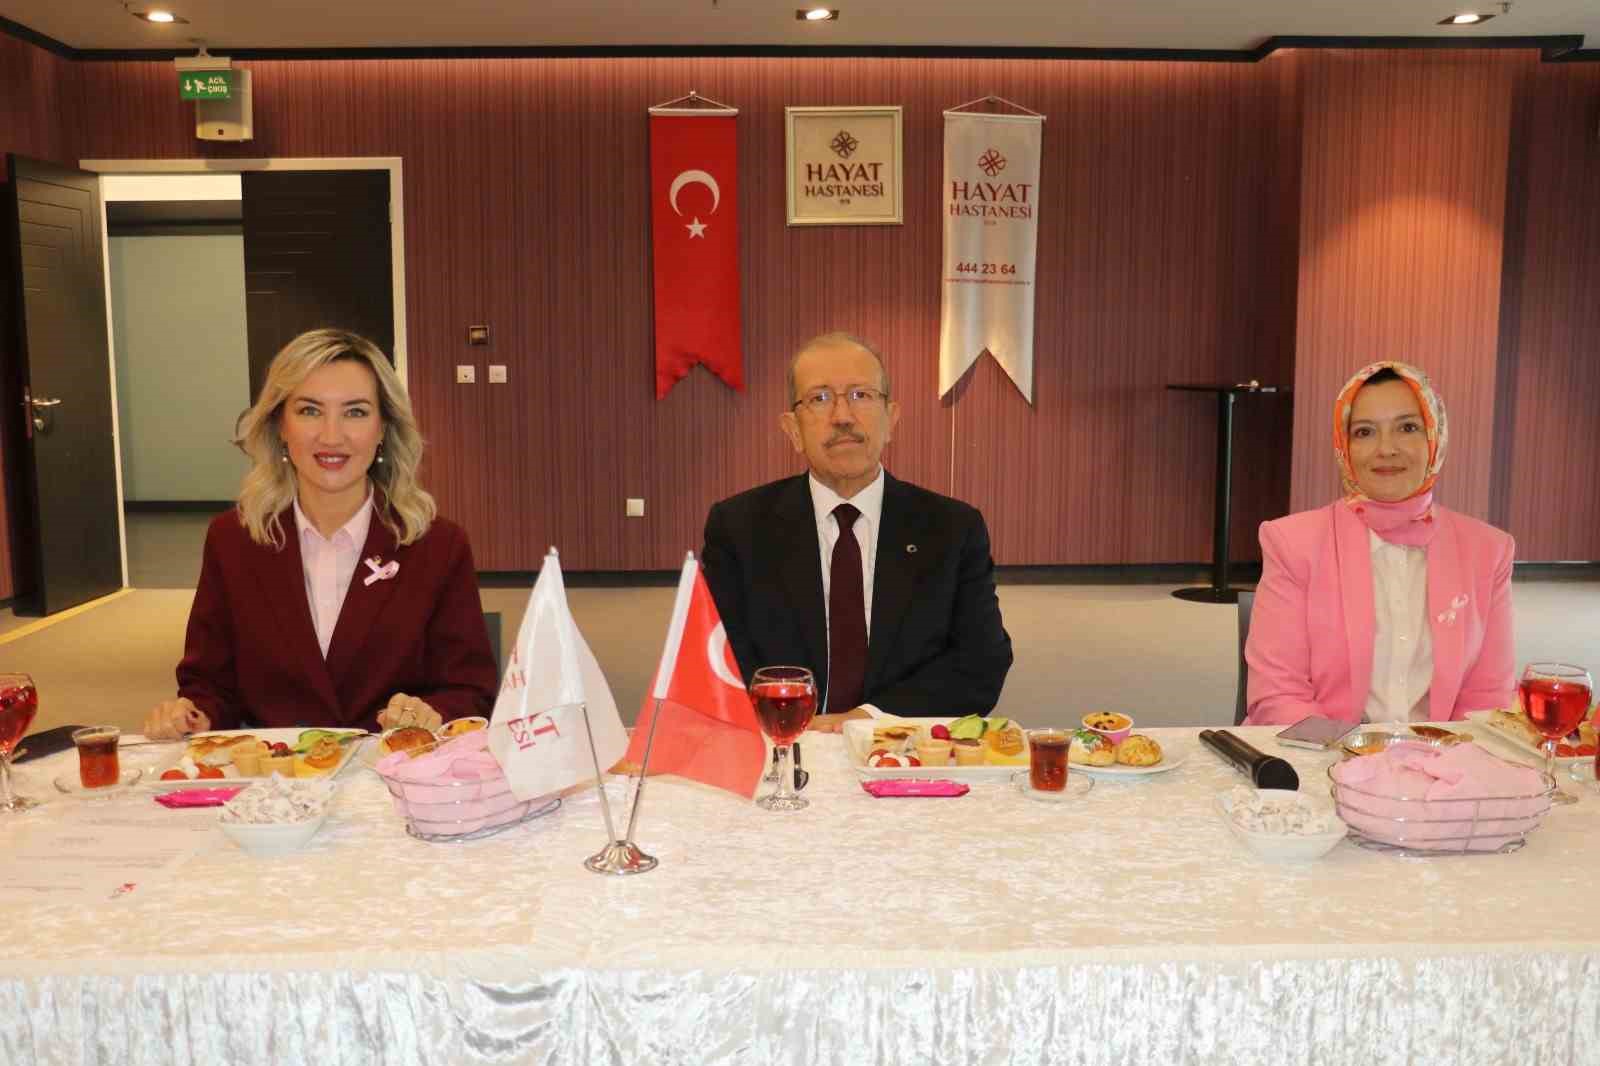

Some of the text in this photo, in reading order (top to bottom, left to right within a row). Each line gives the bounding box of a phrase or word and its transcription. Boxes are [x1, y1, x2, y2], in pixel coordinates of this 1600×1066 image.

[805, 162, 884, 182] HAYAT
[805, 182, 884, 197] HASTANESİ
[952, 181, 1032, 203] HAYAT
[950, 203, 1032, 219] HASTANESİ
[956, 262, 1016, 274] 444 23 64
